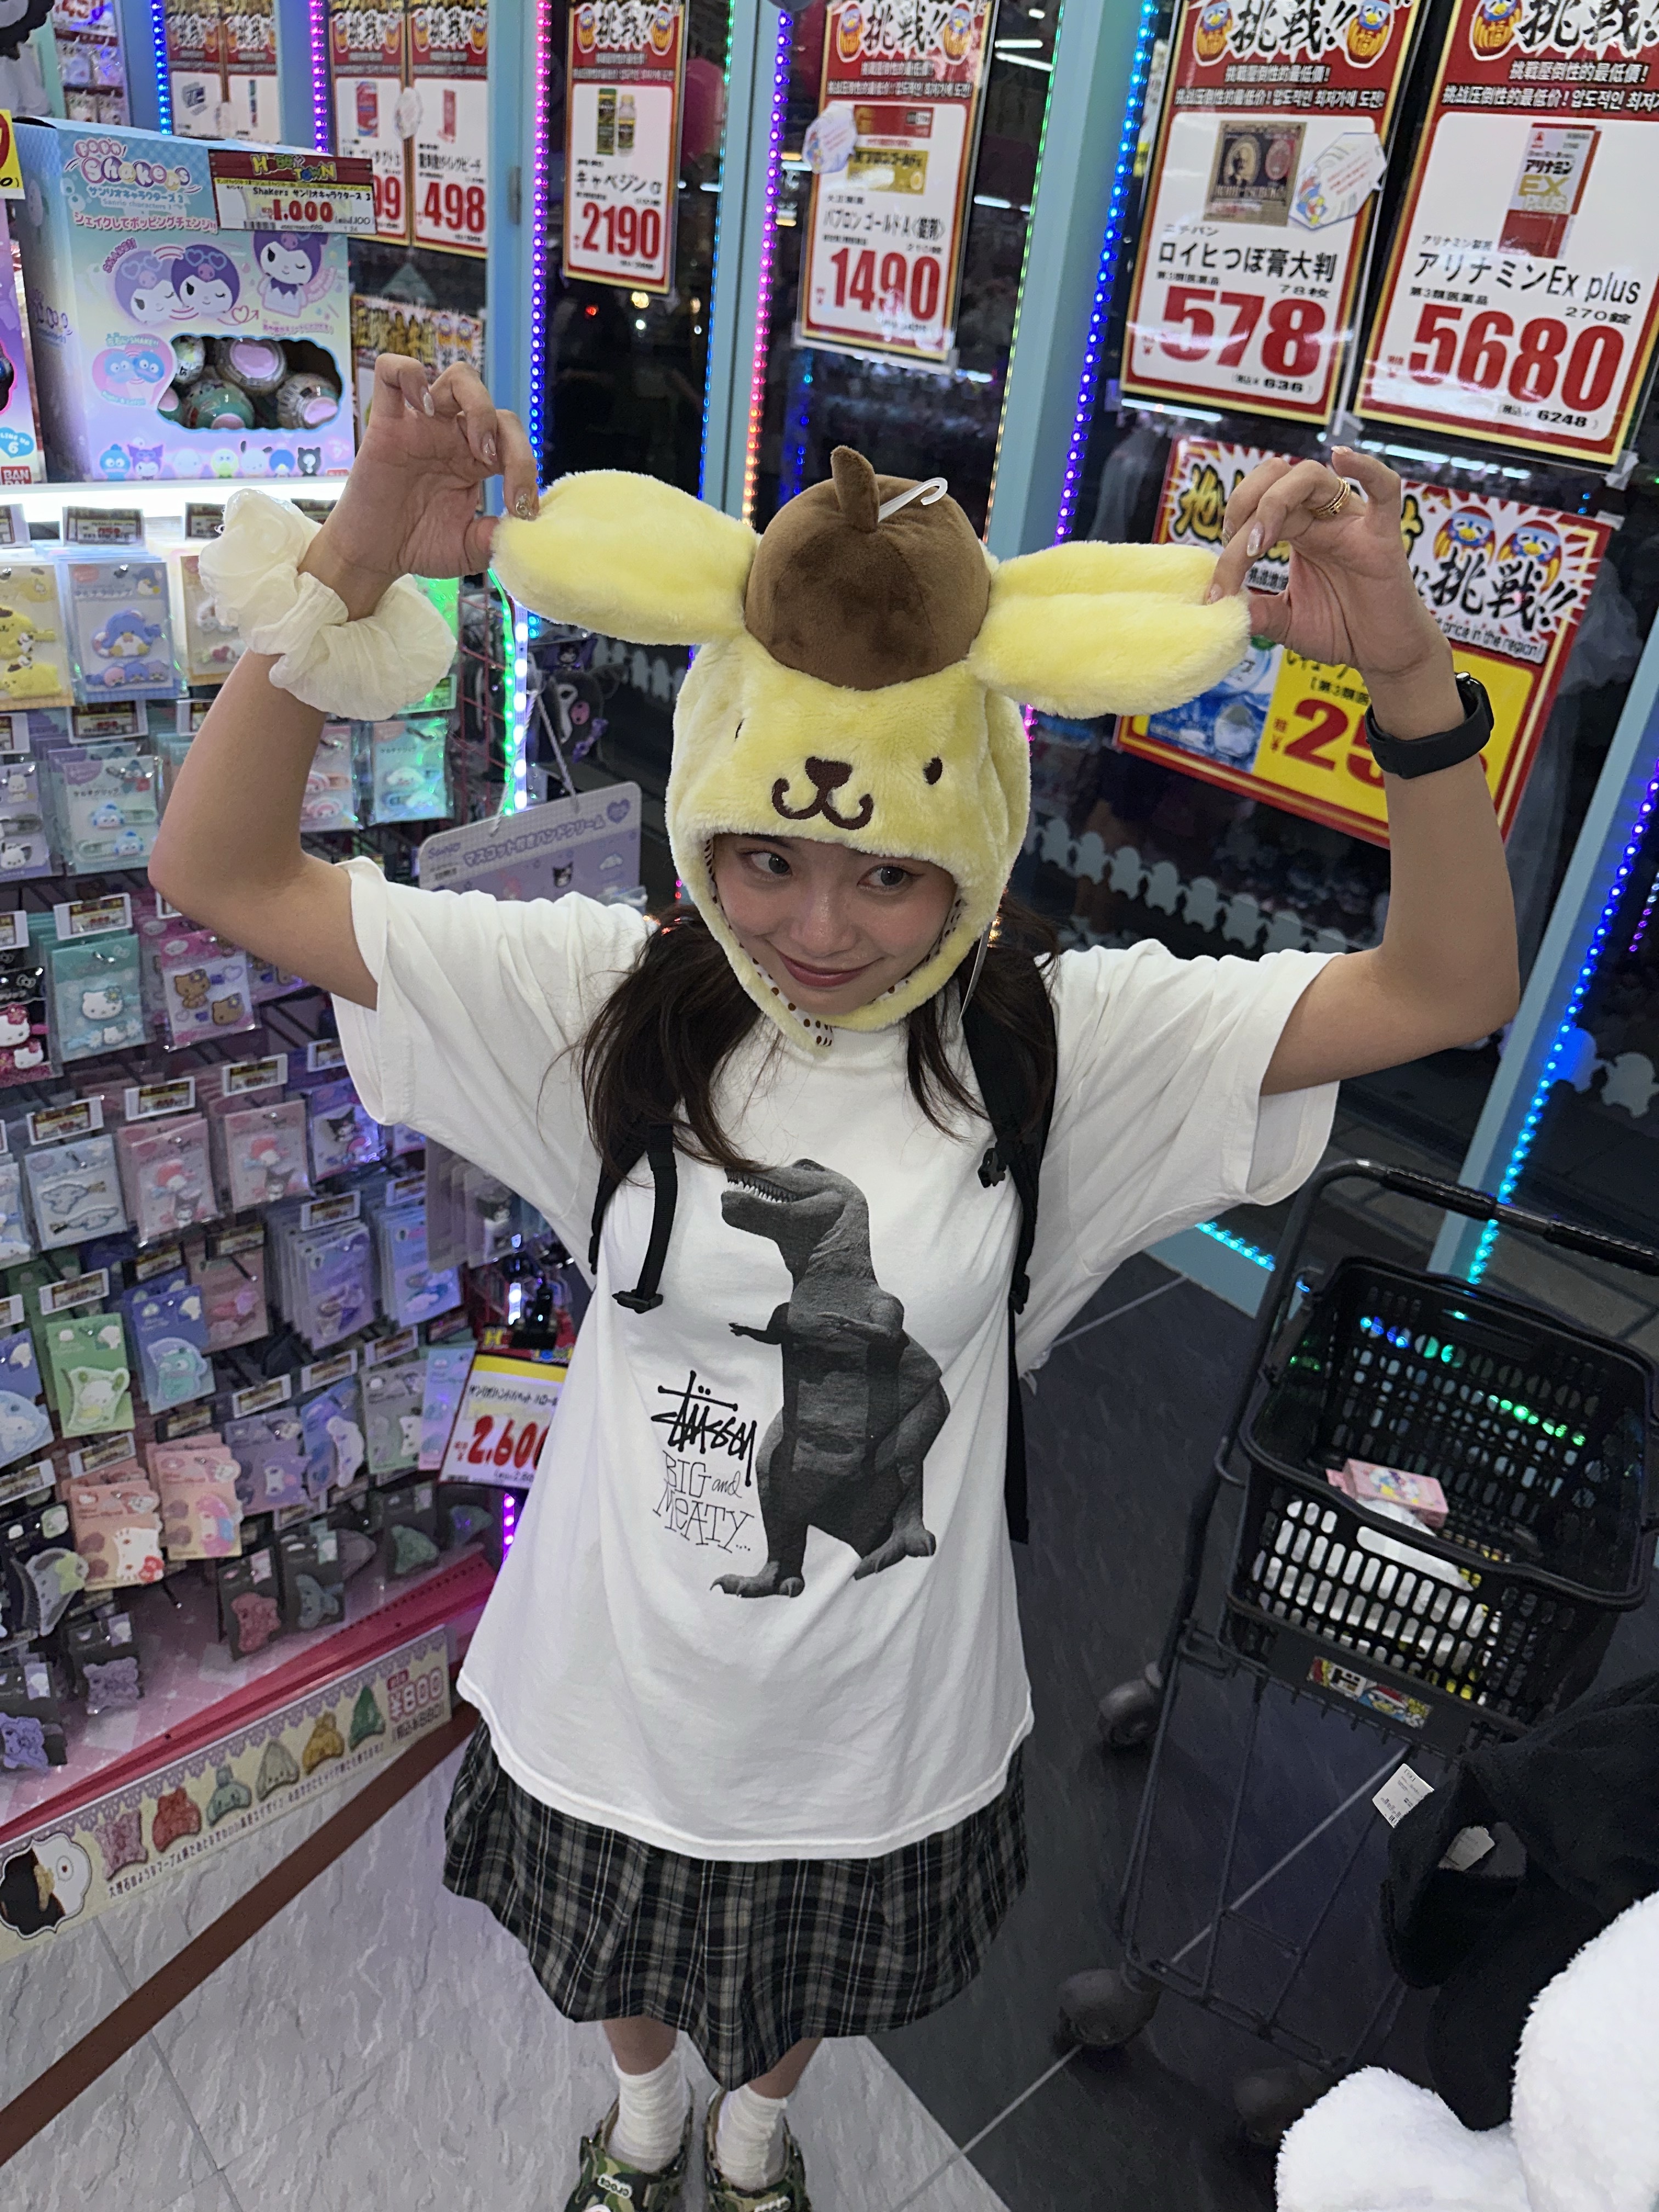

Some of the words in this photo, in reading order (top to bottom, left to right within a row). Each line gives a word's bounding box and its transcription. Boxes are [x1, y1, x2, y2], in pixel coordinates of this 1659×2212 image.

[1229, 0, 1357, 53] 挑戦!!
[81, 155, 191, 191] Shakers
[293, 162, 336, 181] TOWN
[1518, 174, 1570, 196] EX
[253, 186, 289, 196] Shakers
[424, 182, 486, 233] 498
[583, 202, 660, 261] 2190
[1159, 241, 1338, 283] ロイヒつぼ膏大判
[830, 247, 940, 321] 1490
[1584, 272, 1642, 305] plus
[1160, 286, 1326, 377] 578
[1565, 306, 1633, 326] 270錠
[1409, 303, 1624, 412] 5680
[1537, 409, 1588, 428] 6248
[8, 441, 19, 454] 6
[3, 469, 30, 481] BAN
[662, 1449, 712, 1498] BIG
[712, 1470, 743, 1499] and
